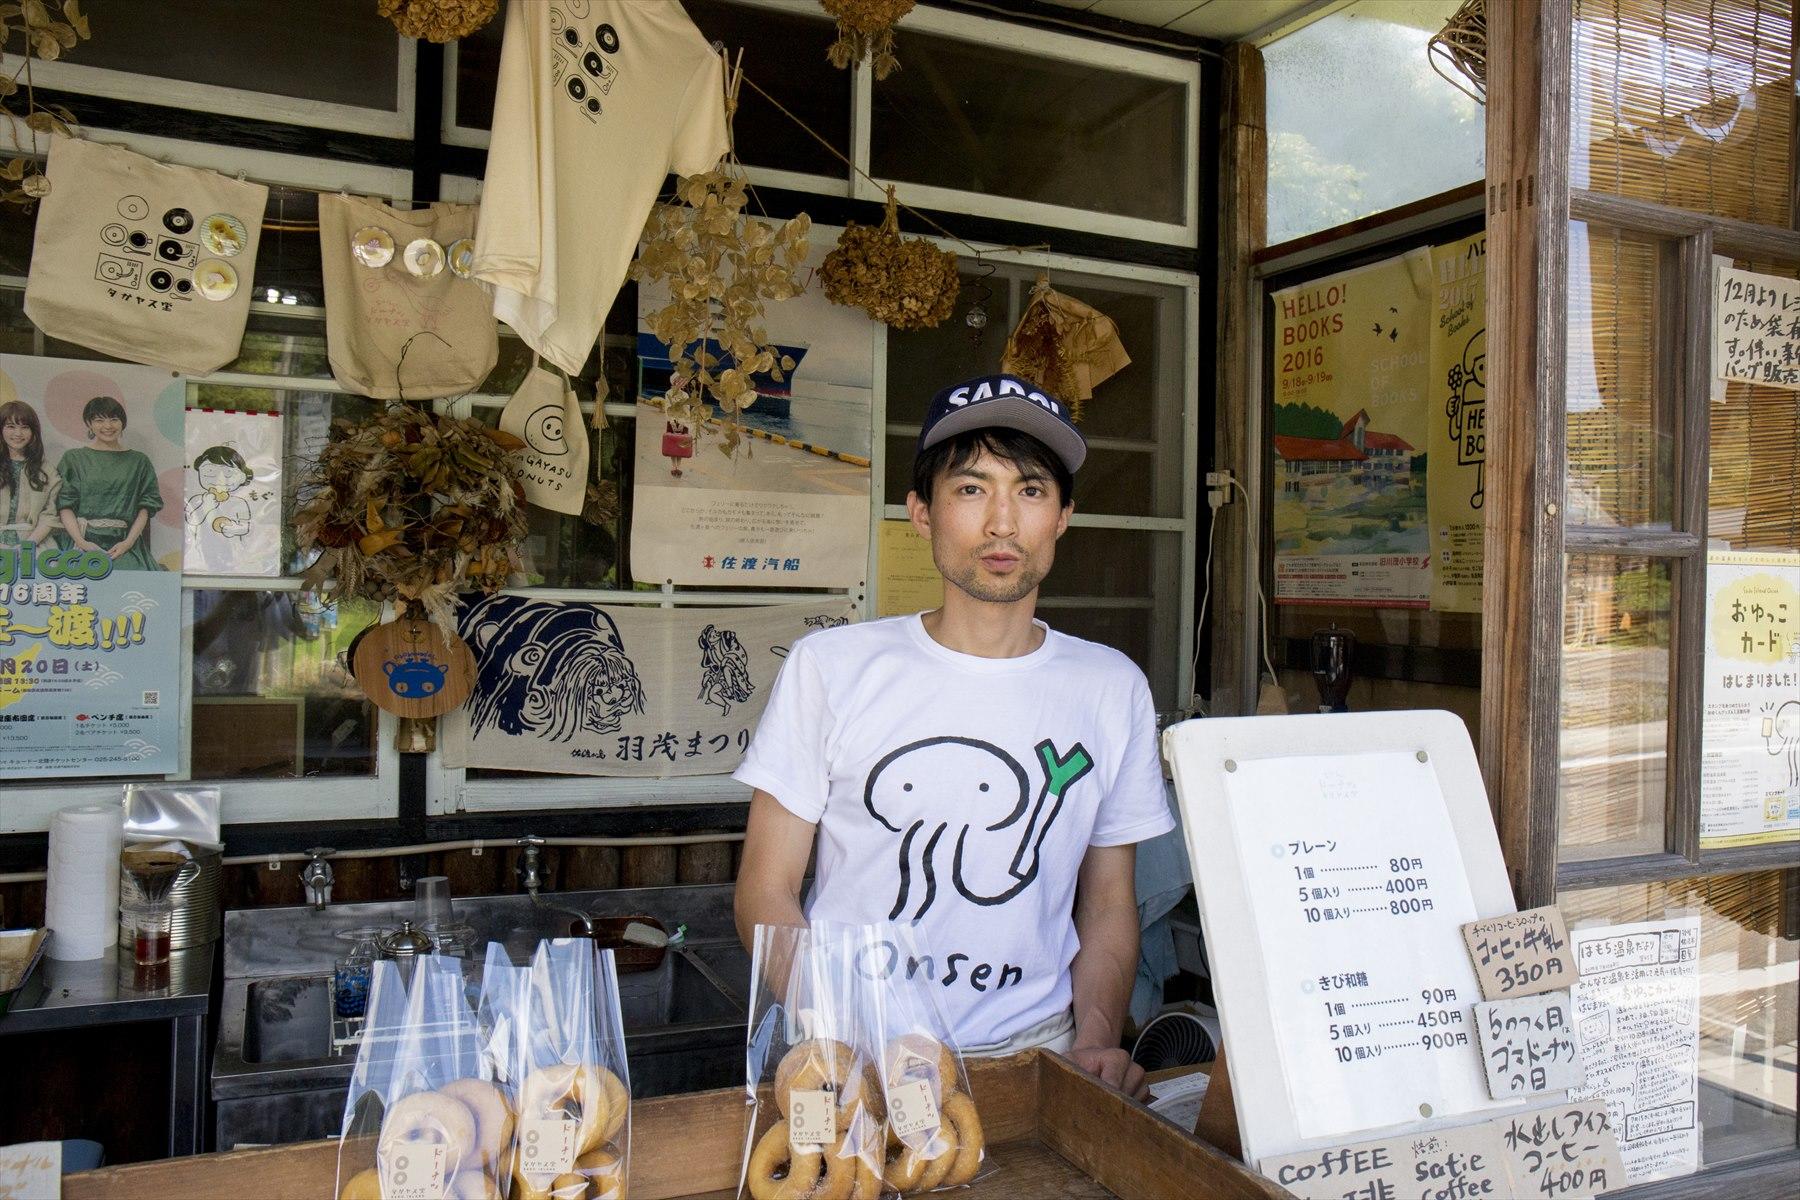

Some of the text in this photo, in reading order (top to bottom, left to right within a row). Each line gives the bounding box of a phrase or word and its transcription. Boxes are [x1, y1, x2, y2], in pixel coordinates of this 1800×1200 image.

[1283, 284, 1347, 319] HELLO!
[1283, 313, 1344, 346] BOOKS
[1282, 346, 1324, 373] 2016
[513, 455, 572, 479] AGAYASU
[517, 469, 563, 491] ONUTS
[721, 556, 800, 571] 佐渡汽船
[1731, 598, 1787, 623] おゆっこ
[1741, 630, 1780, 653] カード
[1722, 673, 1798, 689] はじまりました!
[614, 727, 751, 762] 羽茂まつり
[1289, 840, 1337, 856] プレーン
[1294, 857, 1423, 880] 1個 80円
[1385, 878, 1428, 895] 400円
[1390, 897, 1434, 916] 800円
[1319, 971, 1369, 991] きび和糖
[1495, 957, 1563, 993] 350円
[1325, 988, 1457, 1017] 1個 90円
[1417, 1010, 1462, 1028] 450円
[1421, 1032, 1468, 1050] 900円
[1491, 1037, 1576, 1074] ゴマドーナツ
[1511, 1066, 1547, 1091] の日
[1522, 1142, 1600, 1174] コーヒー
[1540, 1168, 1607, 1200] 400円
